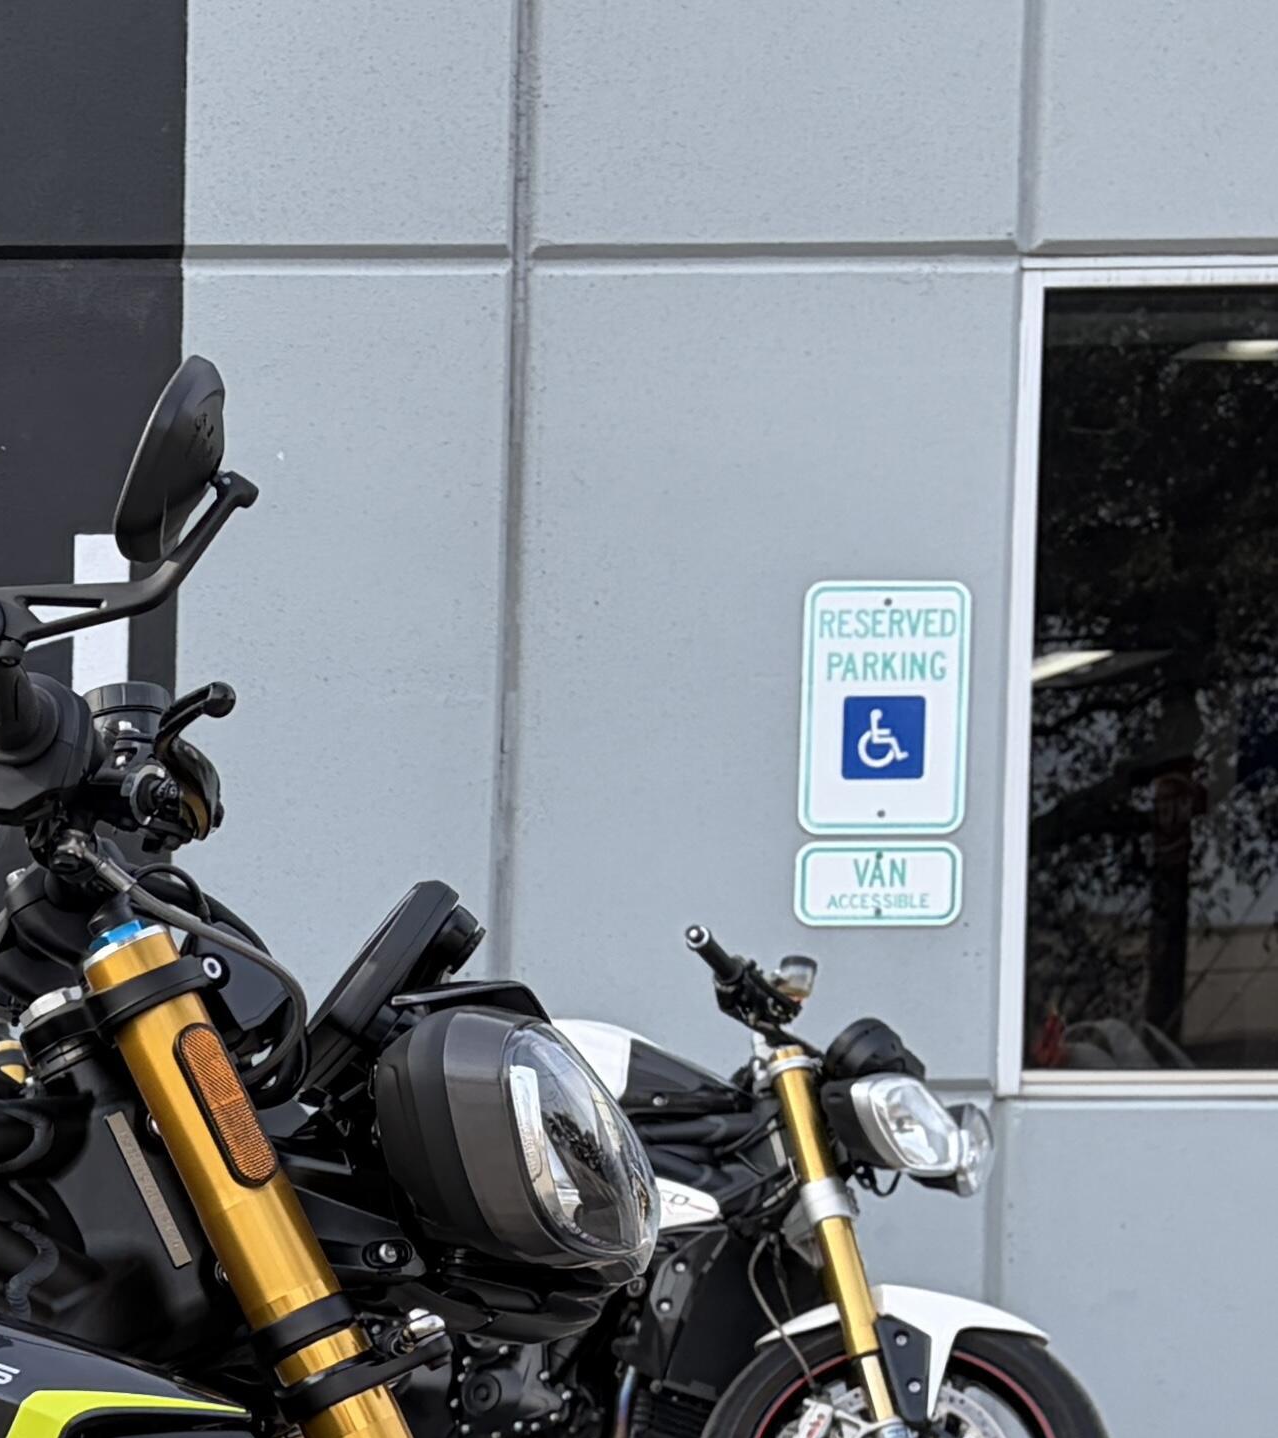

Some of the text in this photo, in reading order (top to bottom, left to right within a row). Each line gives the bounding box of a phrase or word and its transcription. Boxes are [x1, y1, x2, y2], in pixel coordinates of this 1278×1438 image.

[818, 608, 958, 639] RESERVED
[826, 651, 948, 682] PARKING
[853, 858, 907, 888] VAN
[826, 893, 931, 910] ACCESSIBLE
